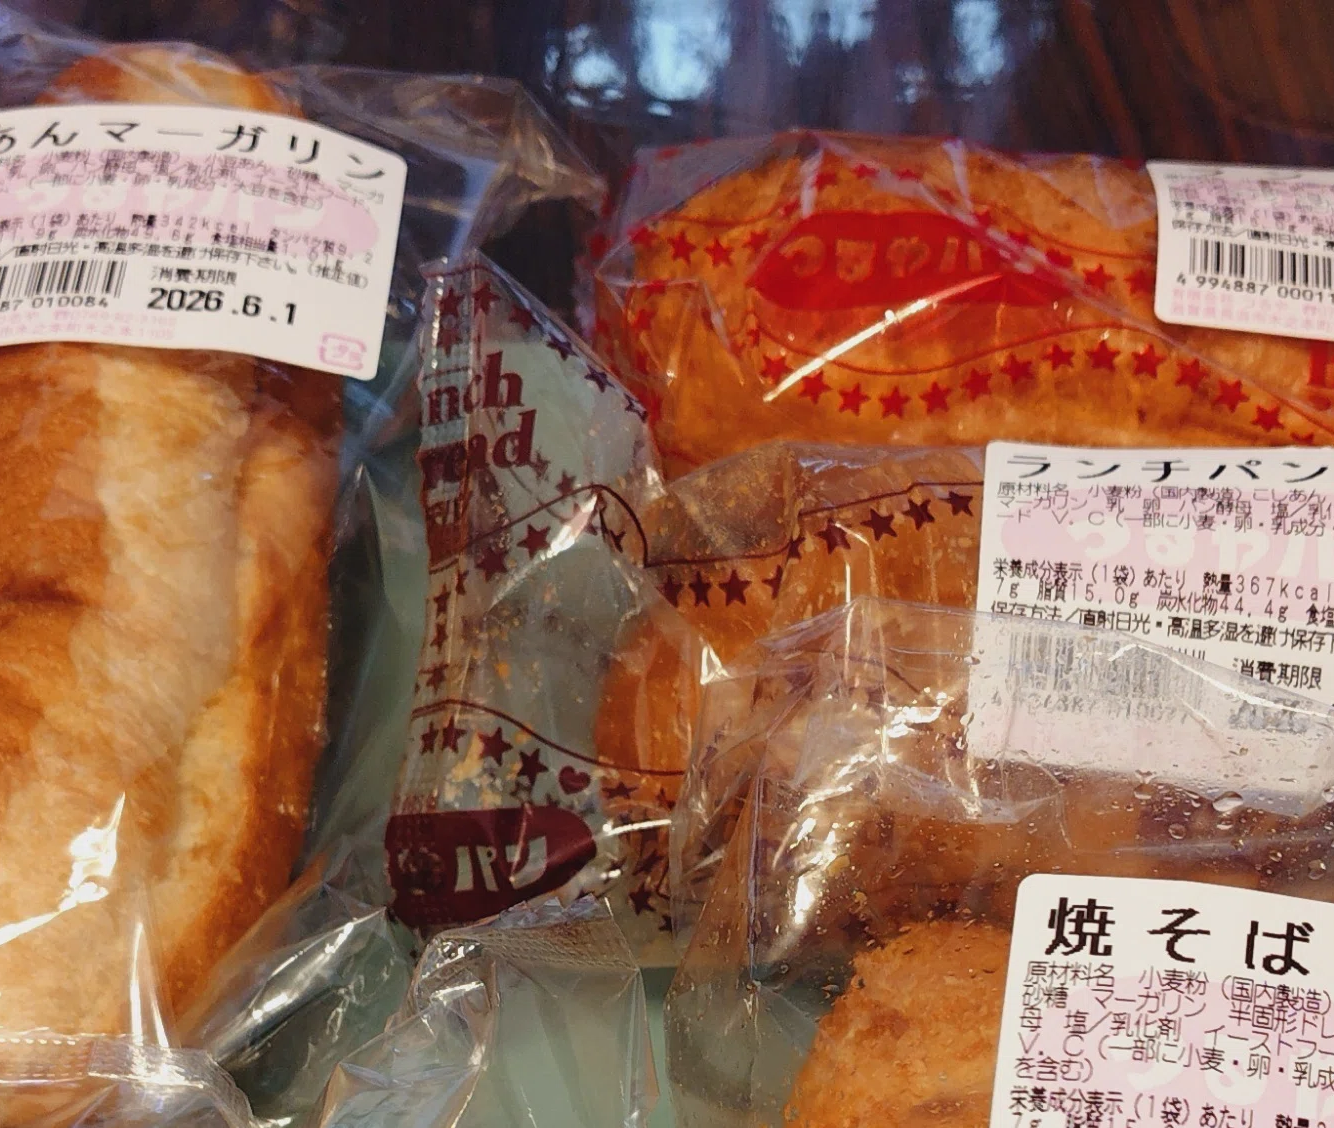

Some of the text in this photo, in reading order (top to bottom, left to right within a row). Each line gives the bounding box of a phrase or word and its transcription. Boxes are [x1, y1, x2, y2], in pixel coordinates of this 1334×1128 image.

[1177, 275, 1186, 285] 4
[1196, 276, 1268, 296] 994887
[32, 296, 108, 308] 010084
[147, 288, 296, 325] 2026.6.1
[997, 482, 1069, 498] 原材料名
[1106, 498, 1124, 513] 乳
[1142, 499, 1161, 514] 卵
[1232, 657, 1323, 690] 消費期限
[1026, 961, 1114, 987] 原材料名
[1022, 984, 1068, 1010] 砂糖
[1091, 989, 1207, 1017] マーガリン
[1019, 1007, 1043, 1032] 母
[1015, 1056, 1093, 1082] を含む）
